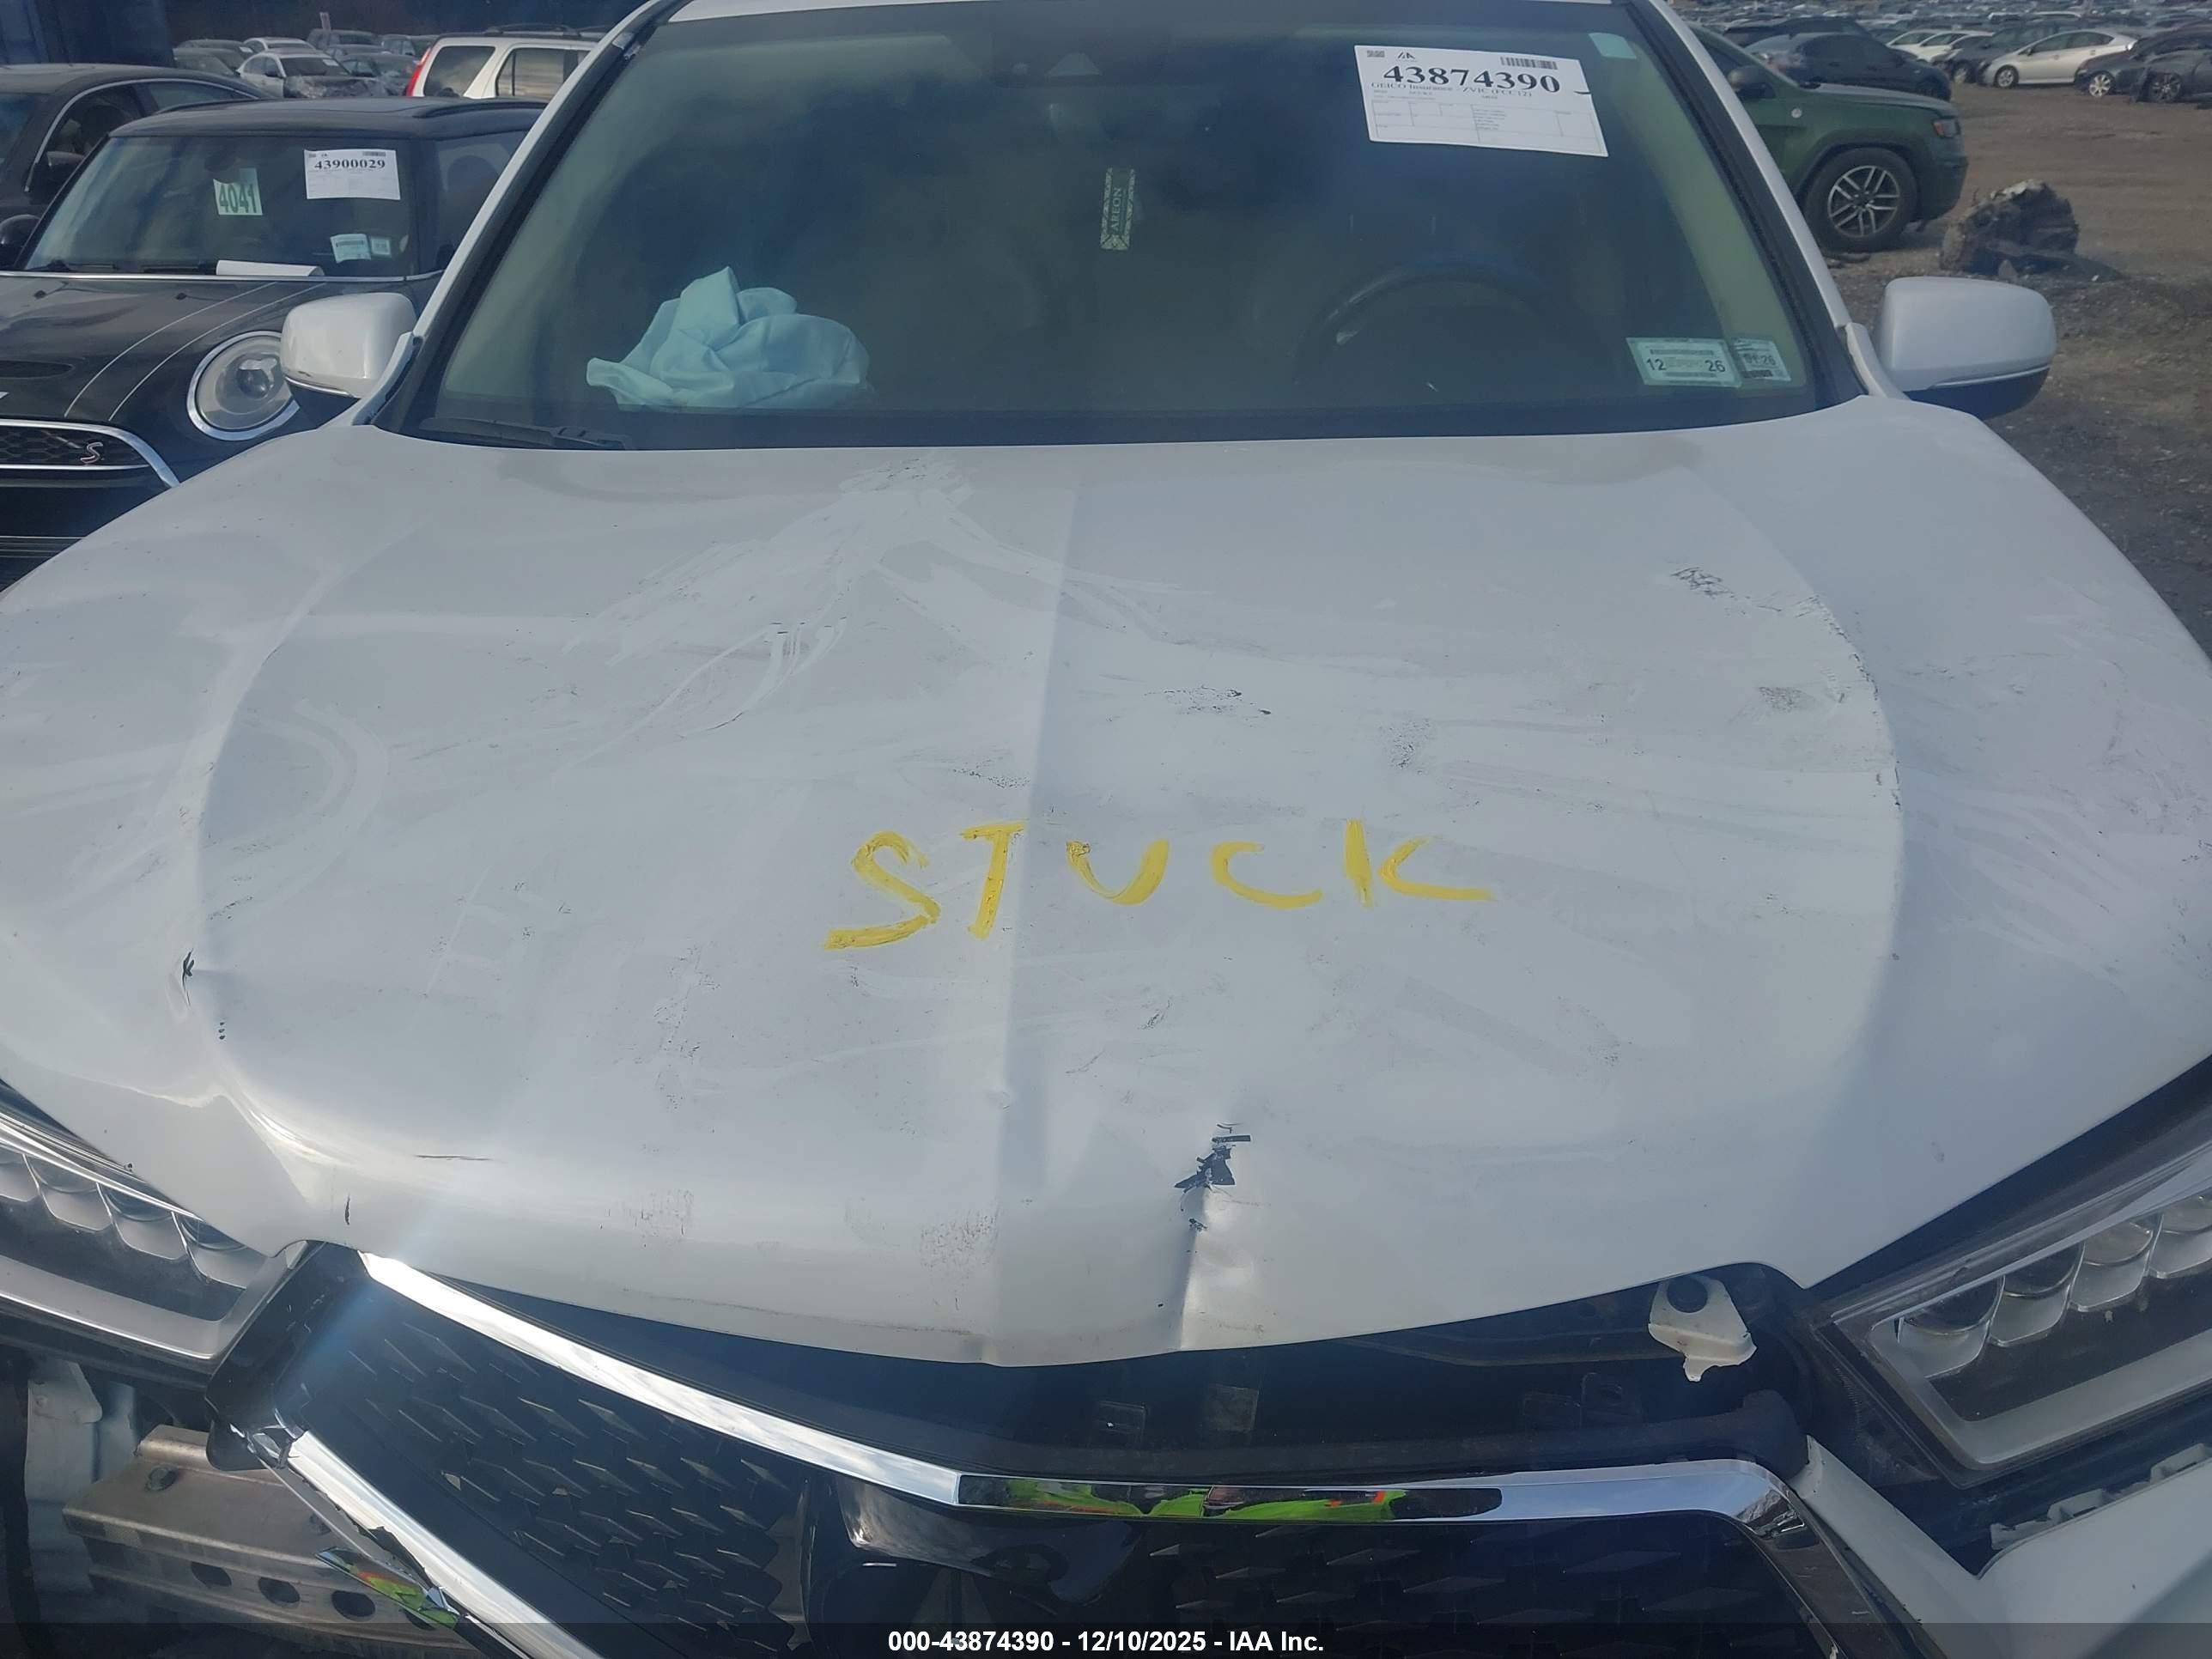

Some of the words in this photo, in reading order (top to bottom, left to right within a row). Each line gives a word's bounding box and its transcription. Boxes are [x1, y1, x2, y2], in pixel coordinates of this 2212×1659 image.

[1383, 65, 1560, 94] 43874390
[314, 159, 386, 170] 43900029
[218, 183, 257, 214] 4041
[1111, 187, 1121, 232] AREON
[1646, 358, 1667, 371] 12
[1705, 360, 1726, 373] 26
[823, 818, 1492, 950] STUCK
